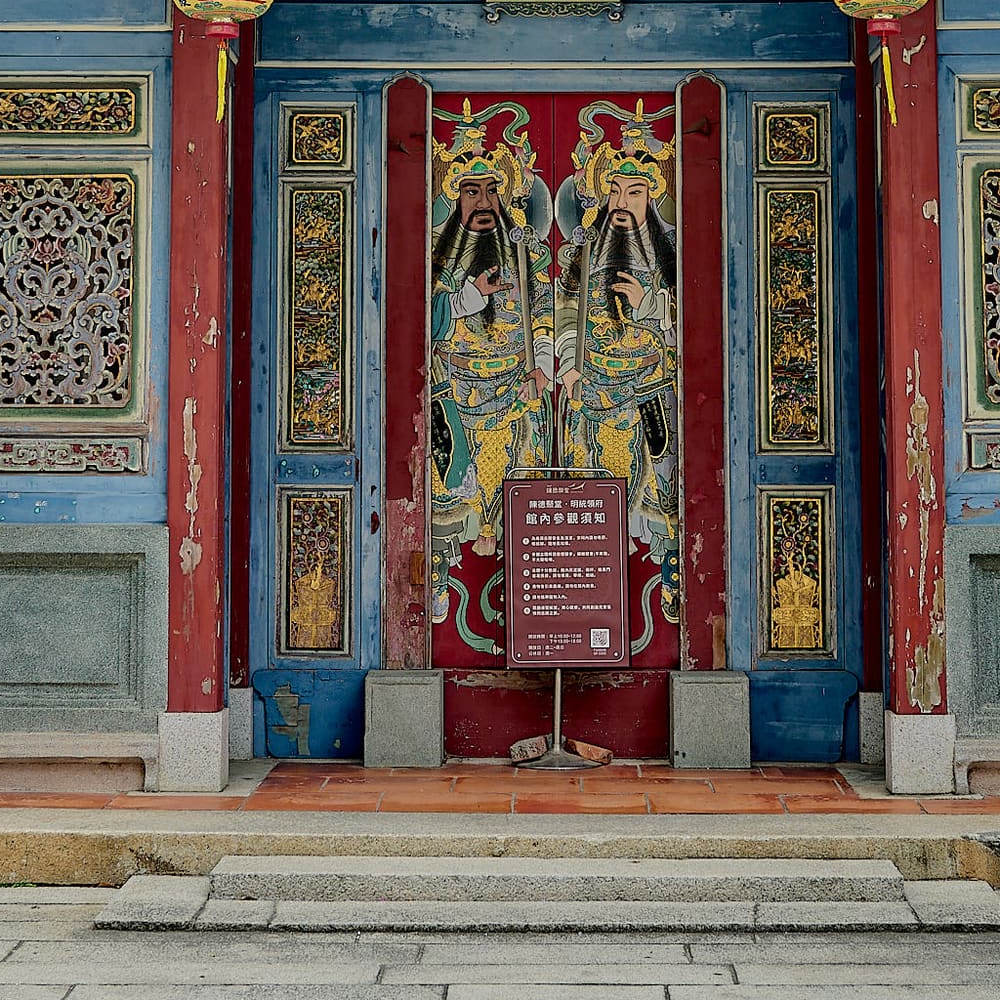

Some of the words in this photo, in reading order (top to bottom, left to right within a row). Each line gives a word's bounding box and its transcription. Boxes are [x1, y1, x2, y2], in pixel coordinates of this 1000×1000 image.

[525, 512, 606, 526] 館內參觀須知
